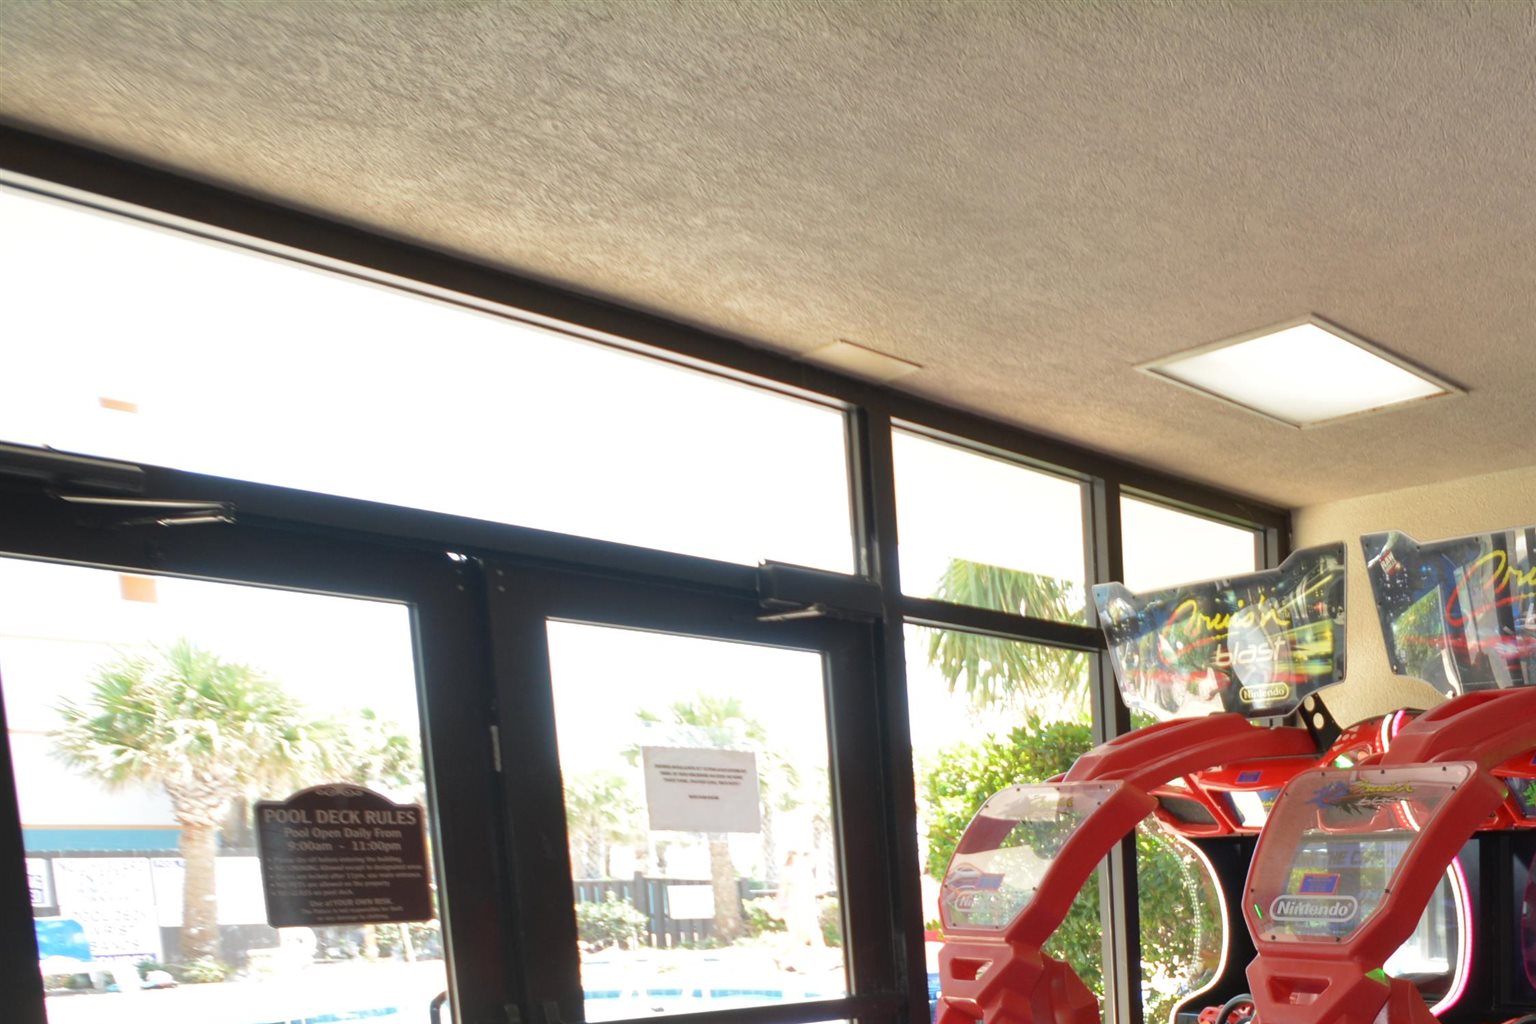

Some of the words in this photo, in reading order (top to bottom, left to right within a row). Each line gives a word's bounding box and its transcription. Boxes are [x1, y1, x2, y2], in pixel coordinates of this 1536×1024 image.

[1211, 636, 1286, 667] blast
[1243, 688, 1286, 699] Nintendo
[263, 809, 311, 824] POOL
[316, 809, 362, 824] DECK
[365, 810, 417, 825] RULES
[284, 827, 309, 838] Pool
[312, 827, 341, 840] Open
[344, 827, 371, 839] Daily
[374, 828, 402, 838] From
[352, 841, 402, 852] 11:00pm
[1277, 901, 1349, 917] Nintendo
